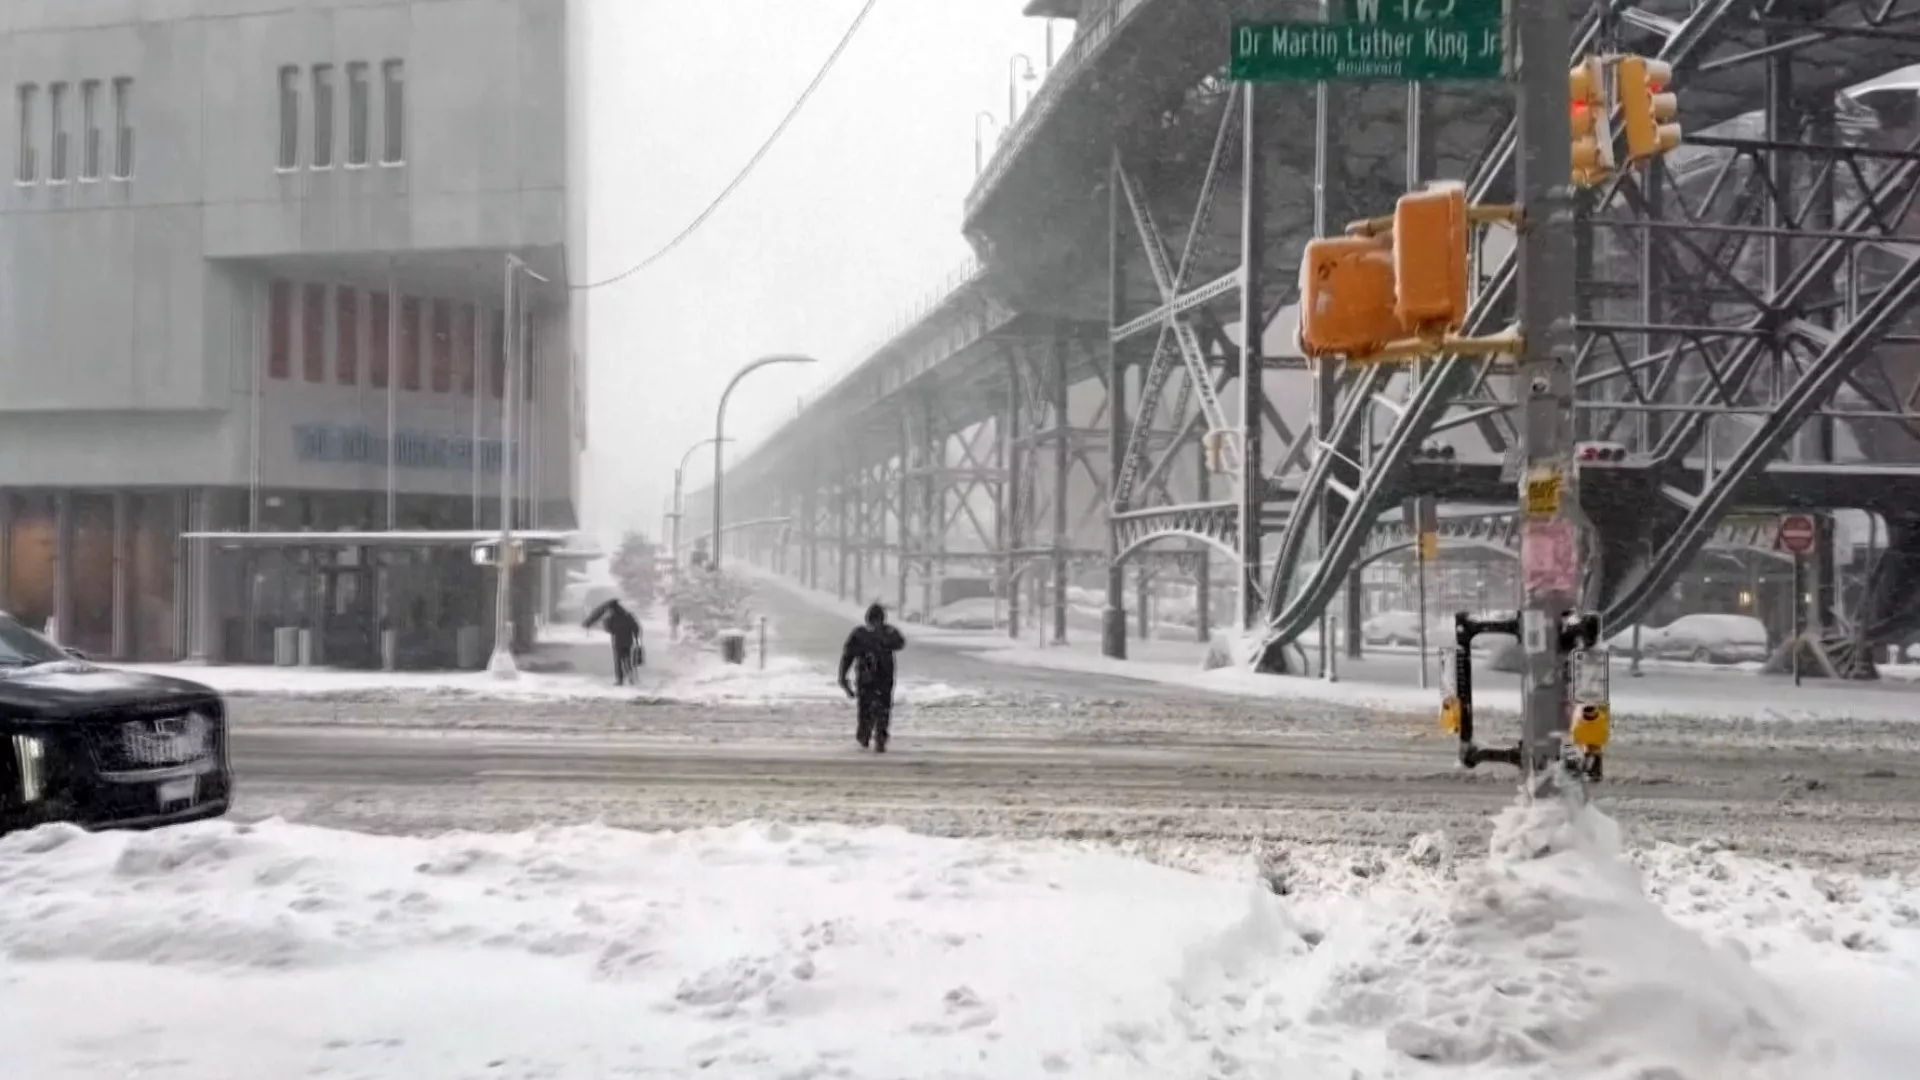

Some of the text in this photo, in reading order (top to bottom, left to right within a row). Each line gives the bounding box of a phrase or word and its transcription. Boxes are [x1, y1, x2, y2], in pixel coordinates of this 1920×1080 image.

[1239, 26, 1497, 65] Dr Martin Luther King Jr
[1336, 59, 1402, 76] Boulevard
